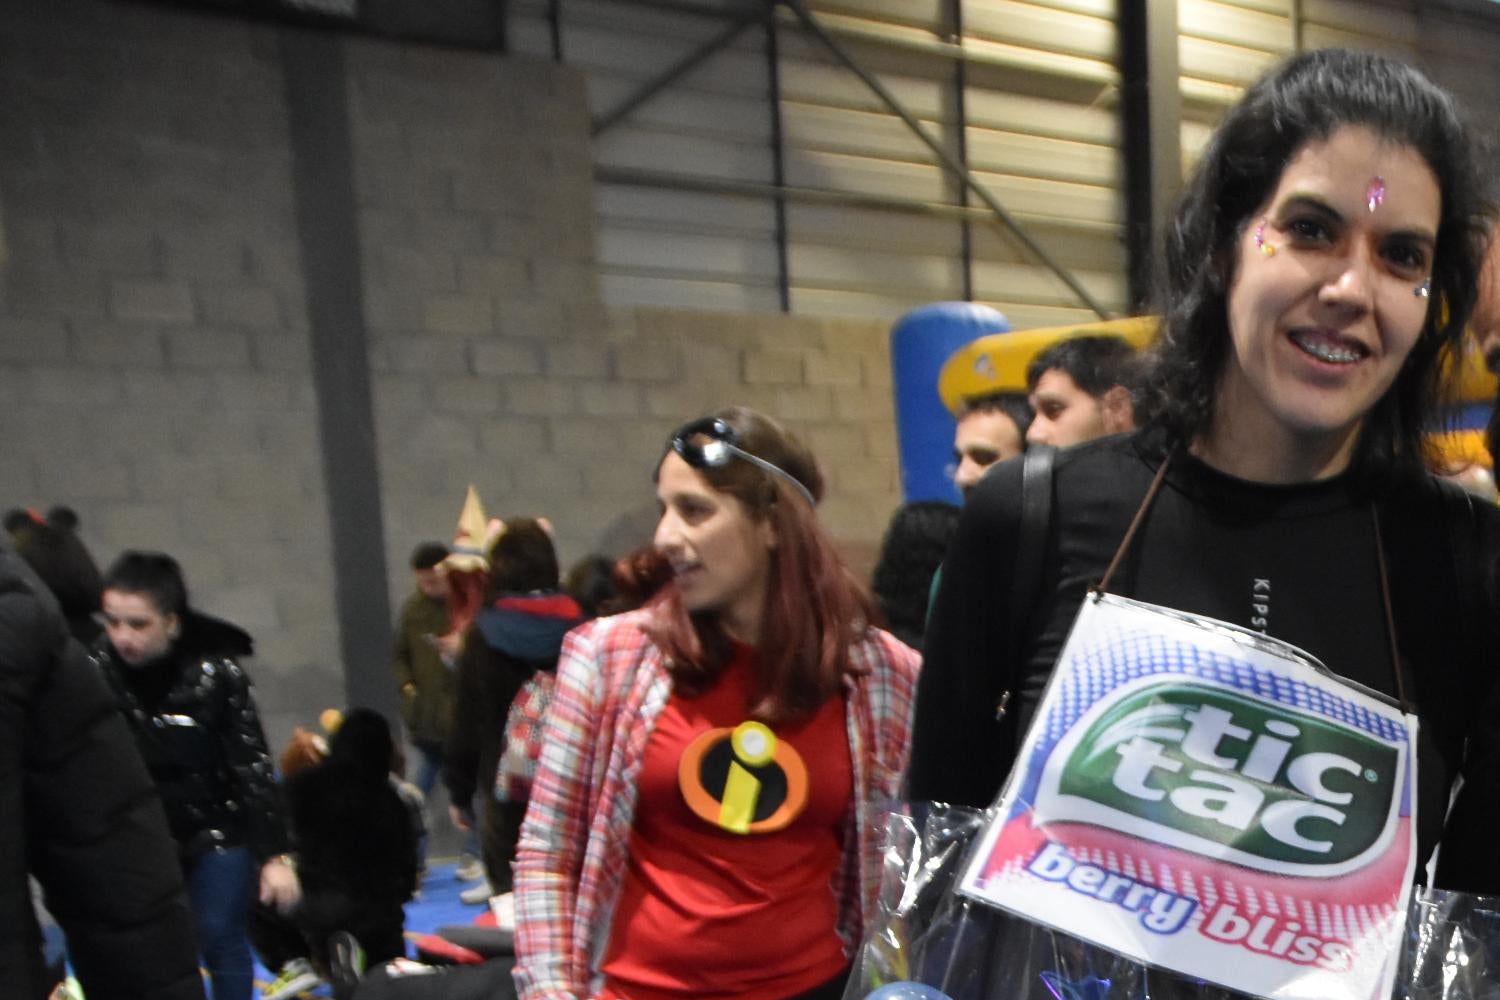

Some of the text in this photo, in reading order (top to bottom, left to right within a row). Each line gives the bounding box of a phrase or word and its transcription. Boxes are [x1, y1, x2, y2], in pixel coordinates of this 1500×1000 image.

[1251, 578, 1271, 635] KIPS
[1112, 736, 1346, 853] tac
[1184, 703, 1362, 806] tic
[1030, 842, 1353, 969] berry bliss
